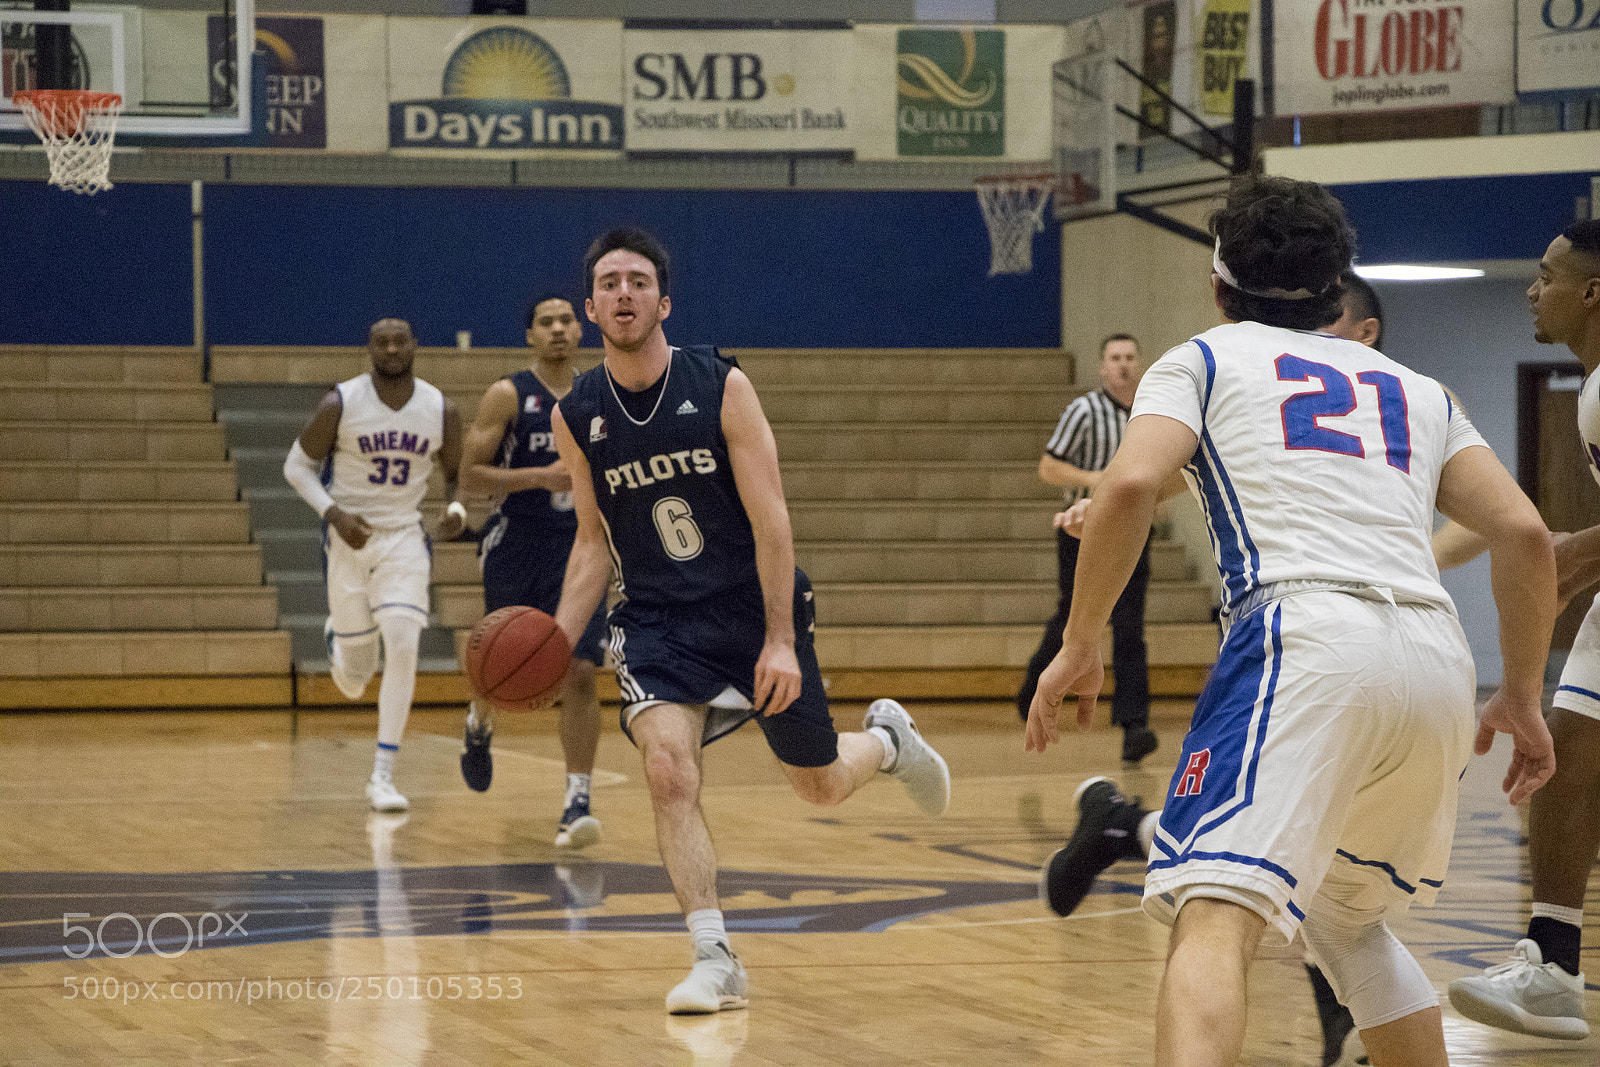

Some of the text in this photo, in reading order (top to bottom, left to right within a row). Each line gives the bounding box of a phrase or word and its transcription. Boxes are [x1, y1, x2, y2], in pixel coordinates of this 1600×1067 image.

[1203, 11, 1250, 50] BEST
[1315, 0, 1463, 80] GLOBE
[633, 53, 767, 101] SMB
[1203, 54, 1246, 93] BUY
[1333, 83, 1450, 105] joplinglobe.com
[404, 105, 611, 148] Days Inn
[634, 106, 845, 130] Southwest Missouri Bank
[899, 106, 999, 135] QUALITY
[1274, 353, 1412, 475] 21
[368, 457, 410, 485] 33
[605, 449, 717, 494] PILOTS
[652, 496, 704, 562] 6
[1174, 748, 1211, 797] R
